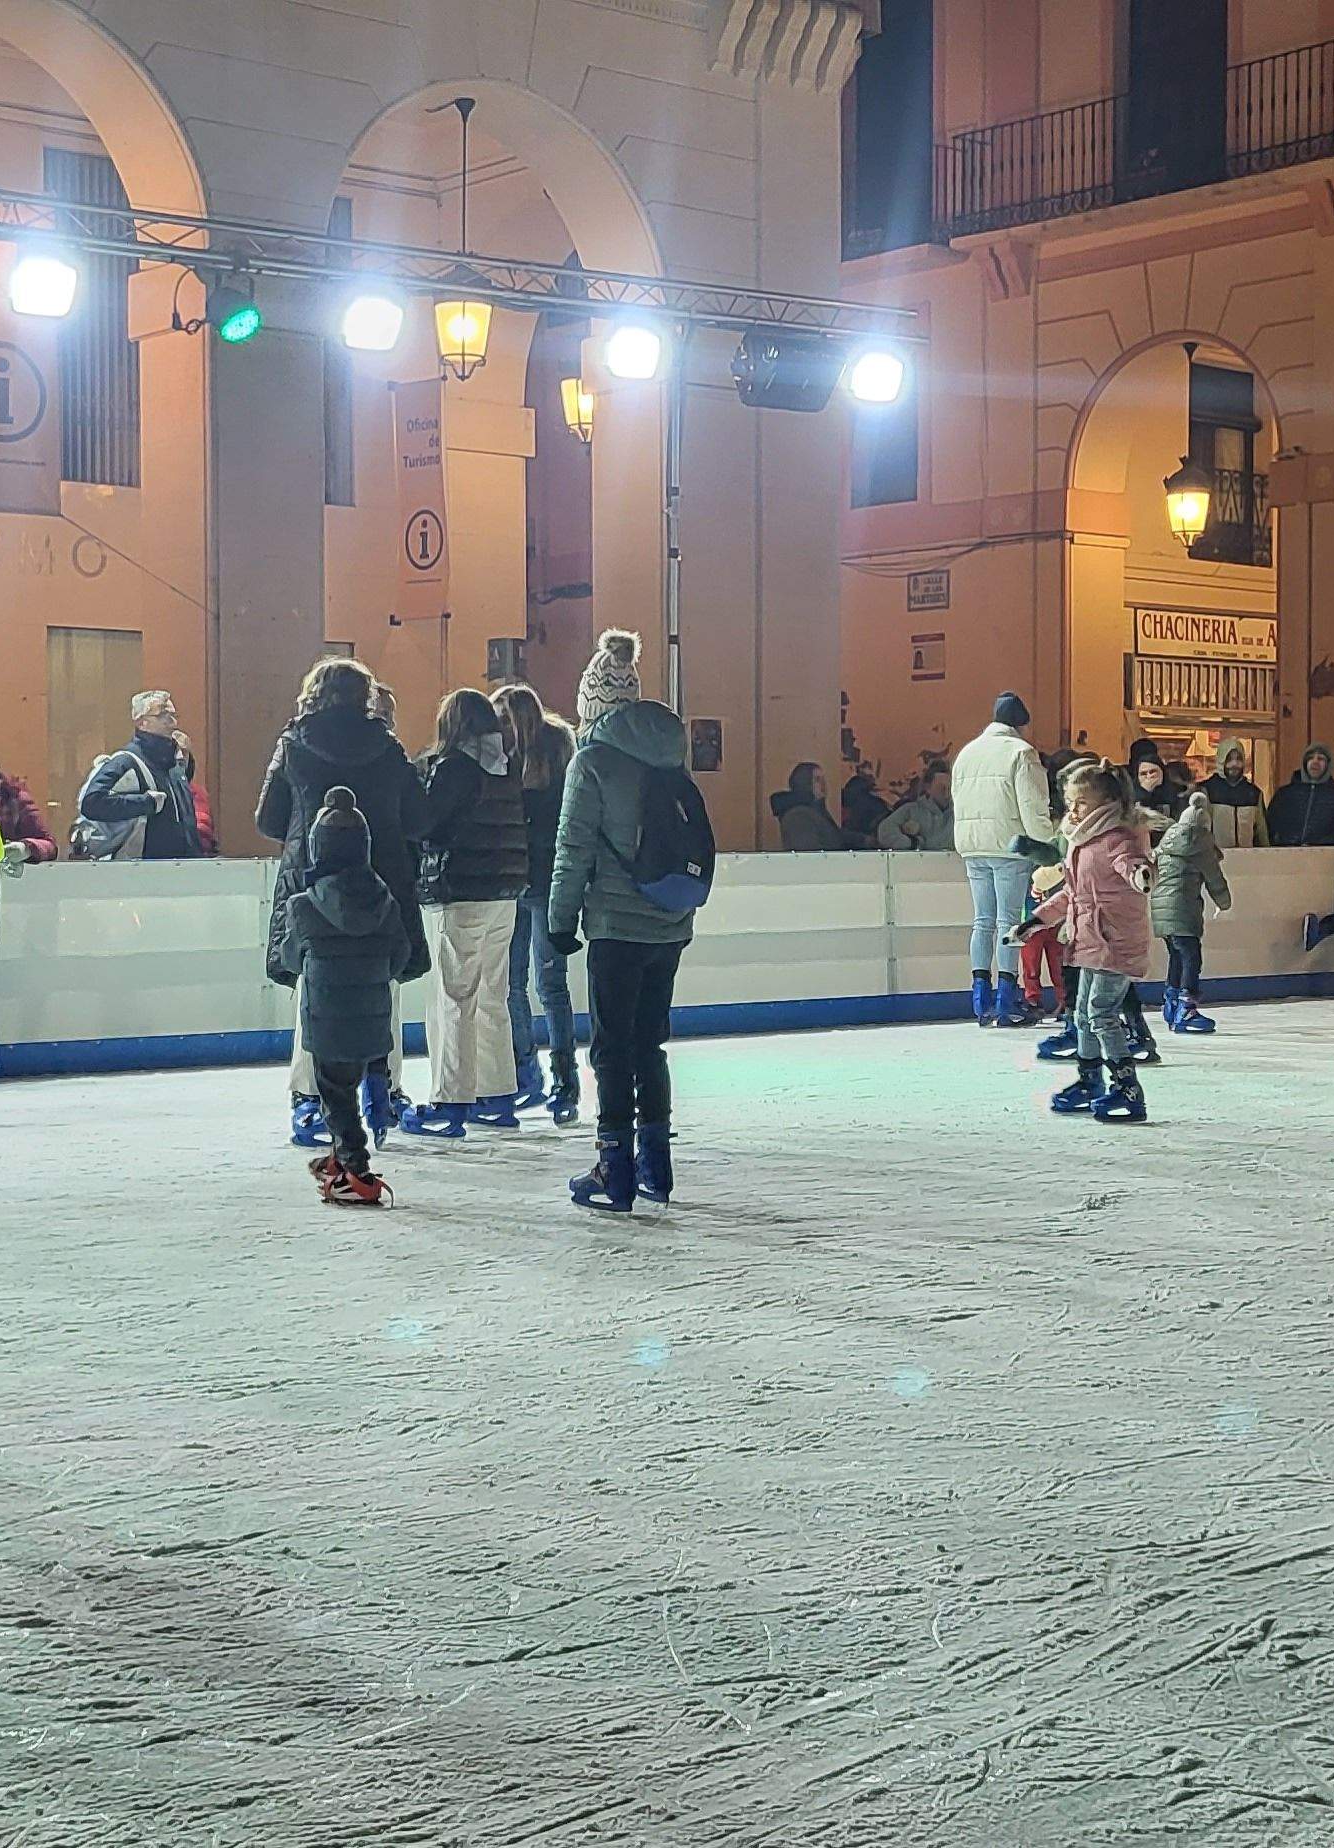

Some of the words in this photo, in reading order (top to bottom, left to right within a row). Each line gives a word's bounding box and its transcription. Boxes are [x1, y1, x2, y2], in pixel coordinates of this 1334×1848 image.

[406, 417, 438, 432] Oficina
[428, 433, 440, 448] de
[402, 454, 440, 468] Turismo
[1141, 613, 1238, 645] CHACINERIA
